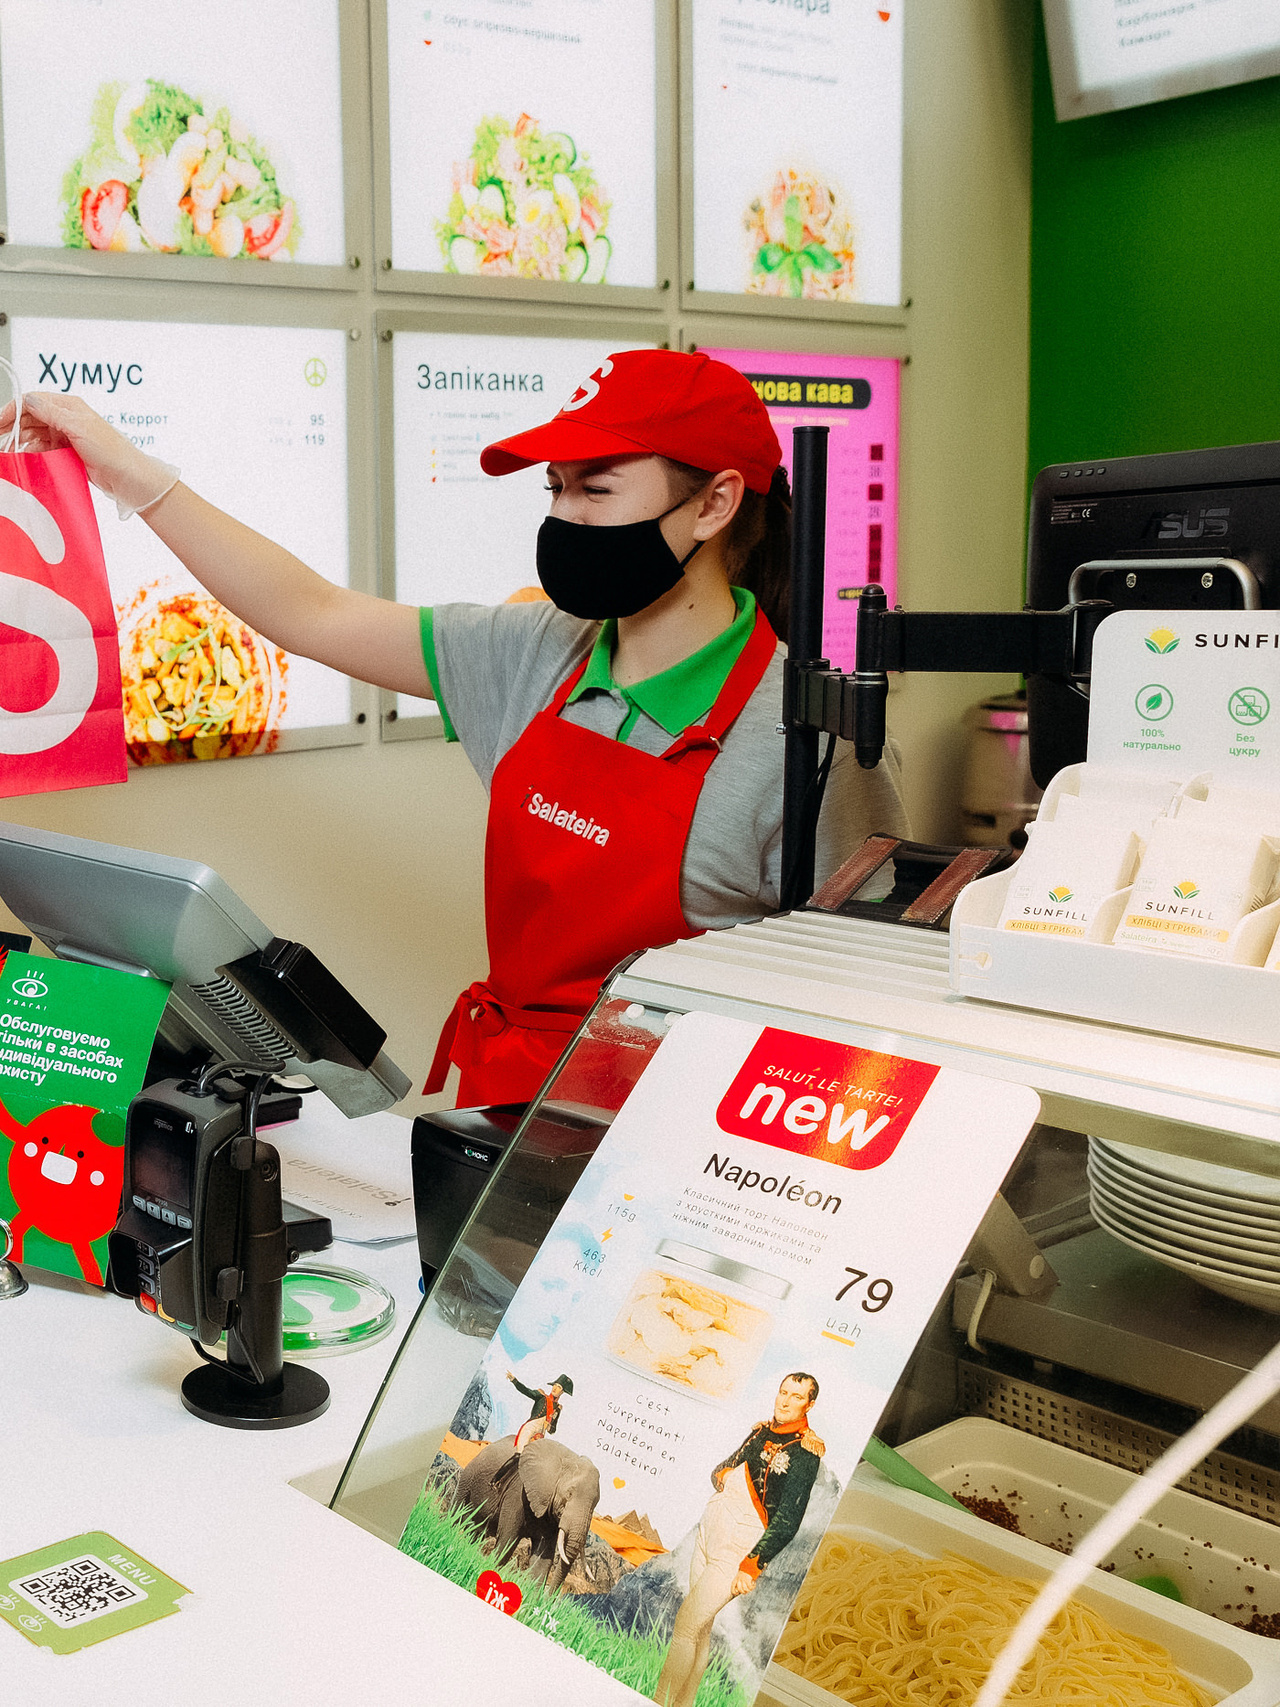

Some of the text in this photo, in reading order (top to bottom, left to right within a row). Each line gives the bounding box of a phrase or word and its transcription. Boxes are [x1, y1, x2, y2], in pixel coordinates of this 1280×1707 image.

[38, 353, 144, 393] Хумус
[417, 364, 544, 392] Запіканка
[120, 412, 169, 428] Керрот
[310, 414, 325, 426] 95
[304, 434, 325, 445] 119
[1122, 741, 1182, 751] натурально
[1140, 728, 1165, 738] 100%
[1236, 733, 1255, 743] Без
[1229, 747, 1261, 757] цукру
[528, 792, 610, 847] Salateira
[1023, 906, 1088, 922] SUNFILL
[1131, 917, 1162, 928] ХЛІБЦІ
[1145, 901, 1214, 921] SUNFILL
[1010, 921, 1040, 931] ХЛІБЦІ
[6, 998, 48, 1011] УВАГА!
[0, 1013, 111, 1049] Обслуговуємо
[45, 1042, 57, 1053] в
[59, 1045, 124, 1068] засобах
[763, 1065, 904, 1108] SALUT LE TARTE!
[739, 1082, 891, 1151] new
[286, 1159, 398, 1200] Salateira
[703, 1153, 843, 1215] Napoléon
[607, 1203, 637, 1223] 115g
[683, 1186, 829, 1241] Класичний торт Наполеон
[672, 1211, 813, 1266] ніжним заварним кремом
[685, 1203, 741, 1226] хрусткими
[743, 1221, 805, 1248] коржиками
[809, 1243, 822, 1254] та
[583, 1248, 607, 1264] 463
[835, 1266, 894, 1313] 79
[825, 1317, 862, 1338] uah
[635, 1394, 671, 1416] C'est
[607, 1401, 686, 1442] surprenant!
[597, 1418, 676, 1463] Napoléon en
[596, 1437, 664, 1477] Salateira!
[107, 1553, 157, 1586] MENU
[484, 1581, 510, 1612] їж
